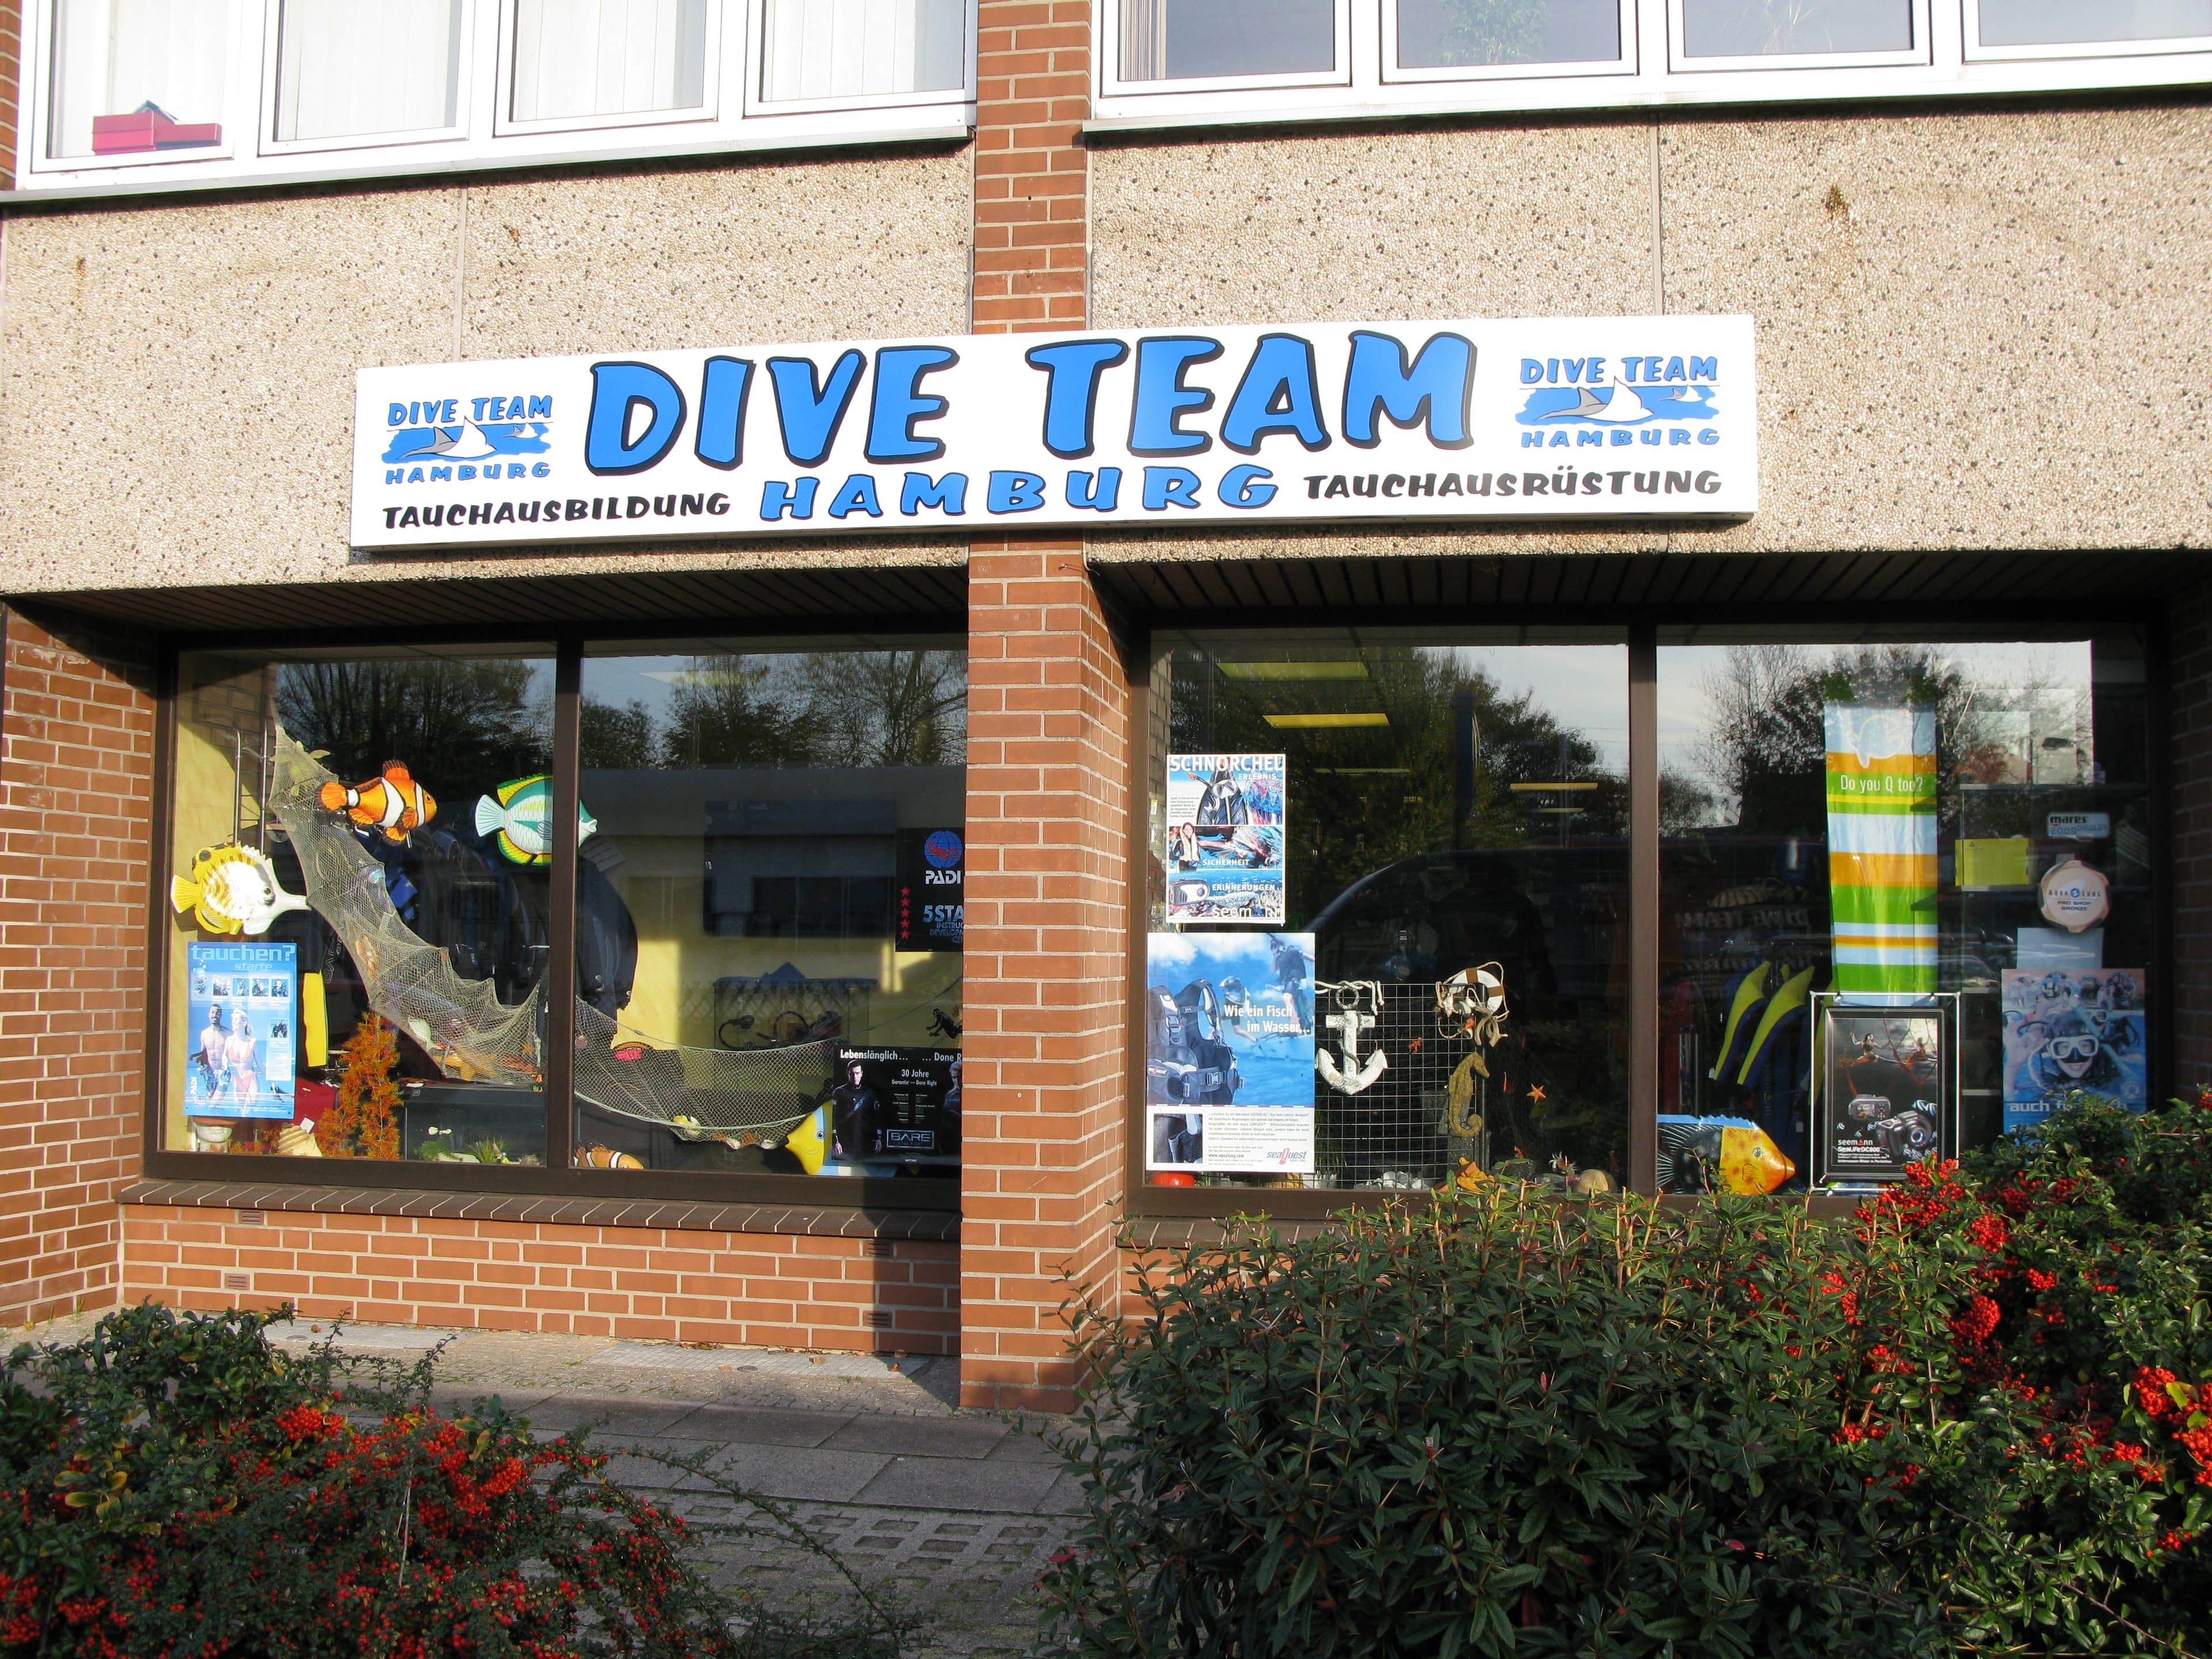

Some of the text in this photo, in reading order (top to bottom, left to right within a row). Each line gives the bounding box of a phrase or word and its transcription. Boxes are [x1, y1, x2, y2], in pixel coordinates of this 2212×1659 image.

[1520, 356, 1718, 384] DIVE TEAM
[388, 395, 552, 426] DIVE TEAM
[585, 330, 1478, 476] DIVE TEAM
[1521, 427, 1719, 448] HAMBURG
[385, 462, 550, 484] HAMBURG
[1304, 465, 1722, 499] TAUCHAUSRÜSTUNG
[760, 464, 1278, 521] HAMBURG
[383, 492, 730, 529] TAUCHAUSBILDUNG
[1170, 756, 1283, 771] SCHNORCHEL
[1840, 775, 1923, 793] Do you Q too?
[926, 870, 961, 884] PADI
[191, 945, 296, 961] tauchen?
[1224, 1005, 1292, 1018] Wie ein Fisch
[1247, 1021, 1260, 1033] im
[934, 1052, 954, 1061] Done
[902, 1069, 929, 1078] 30 Jahre
[2010, 1100, 2050, 1112] auch
[891, 1132, 930, 1142] BARE
